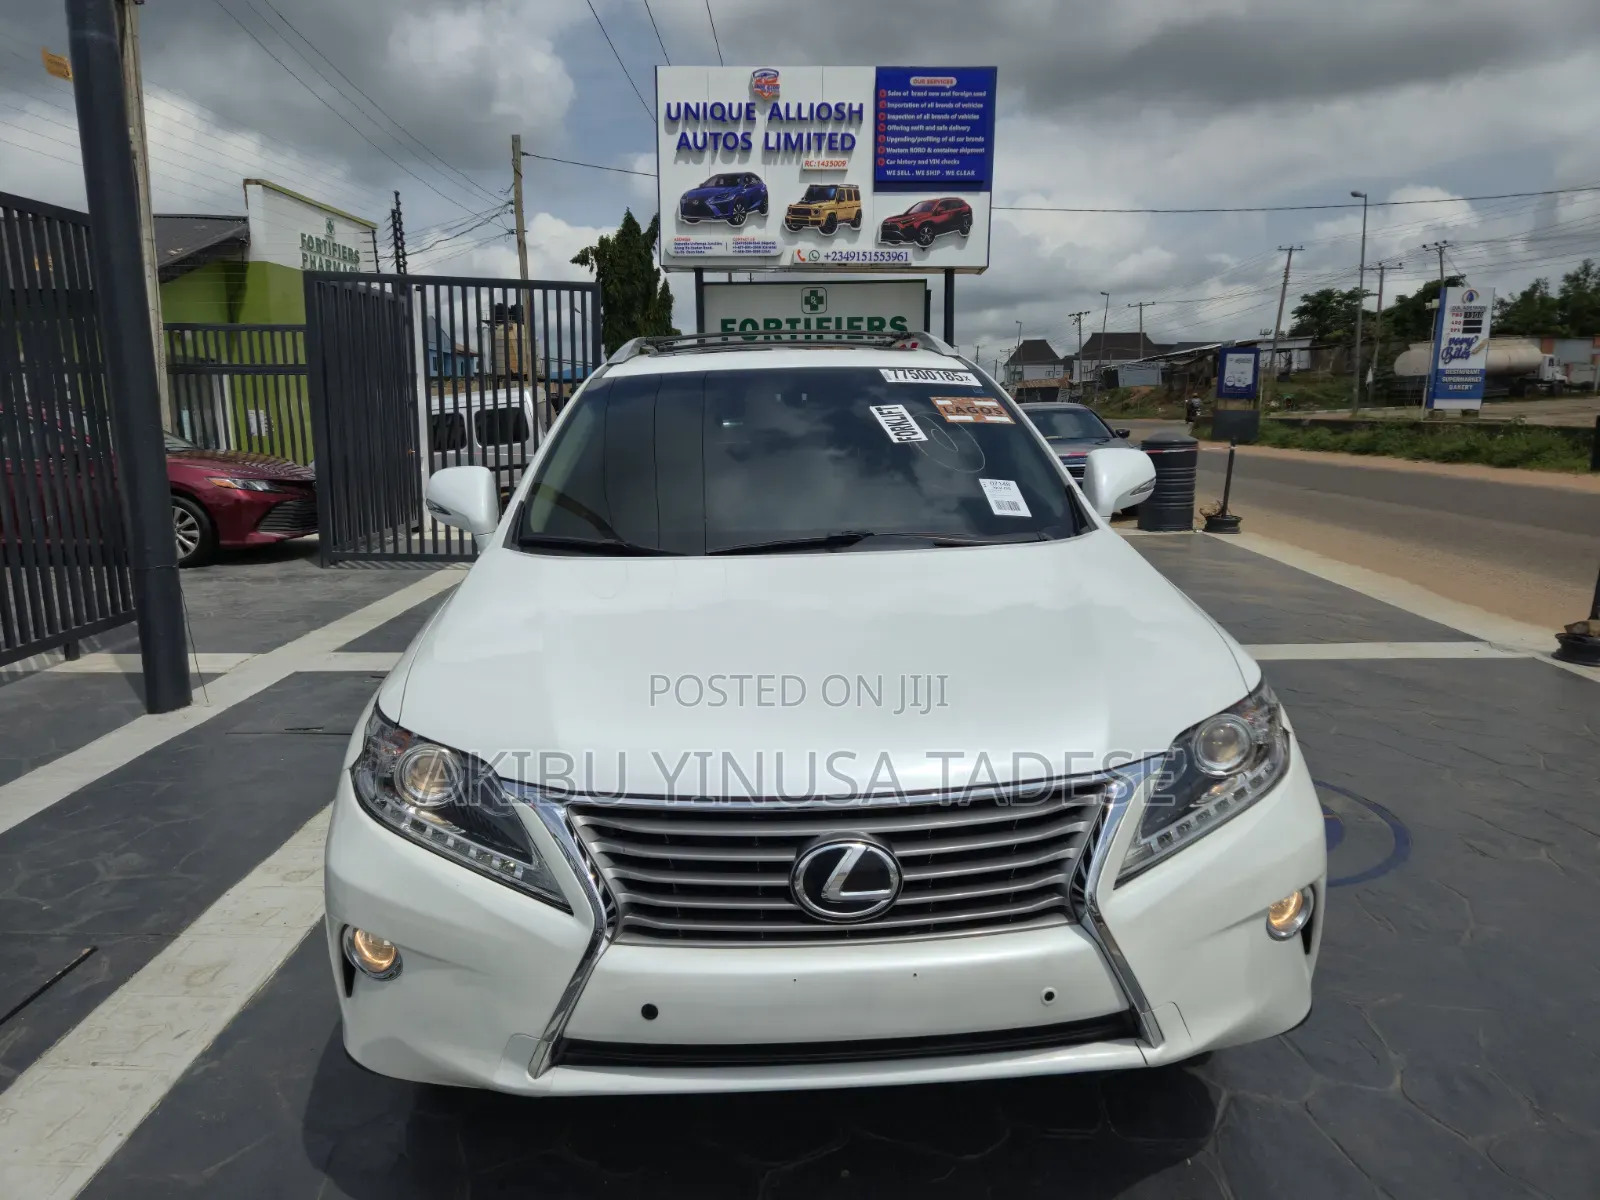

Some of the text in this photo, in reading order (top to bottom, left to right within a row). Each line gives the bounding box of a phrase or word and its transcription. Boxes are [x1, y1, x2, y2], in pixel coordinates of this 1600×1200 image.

[666, 102, 864, 122] UNIQUE ALLIOSH
[676, 132, 856, 151] AUTOS LIMITED
[804, 160, 847, 168] RC:1435009
[300, 232, 360, 264] FORTIFIERS
[824, 251, 909, 262] +2349151553961
[720, 316, 909, 342] FORTIFIERS
[942, 405, 1004, 416] LAGOS
[875, 406, 925, 442] FORKLIFT
